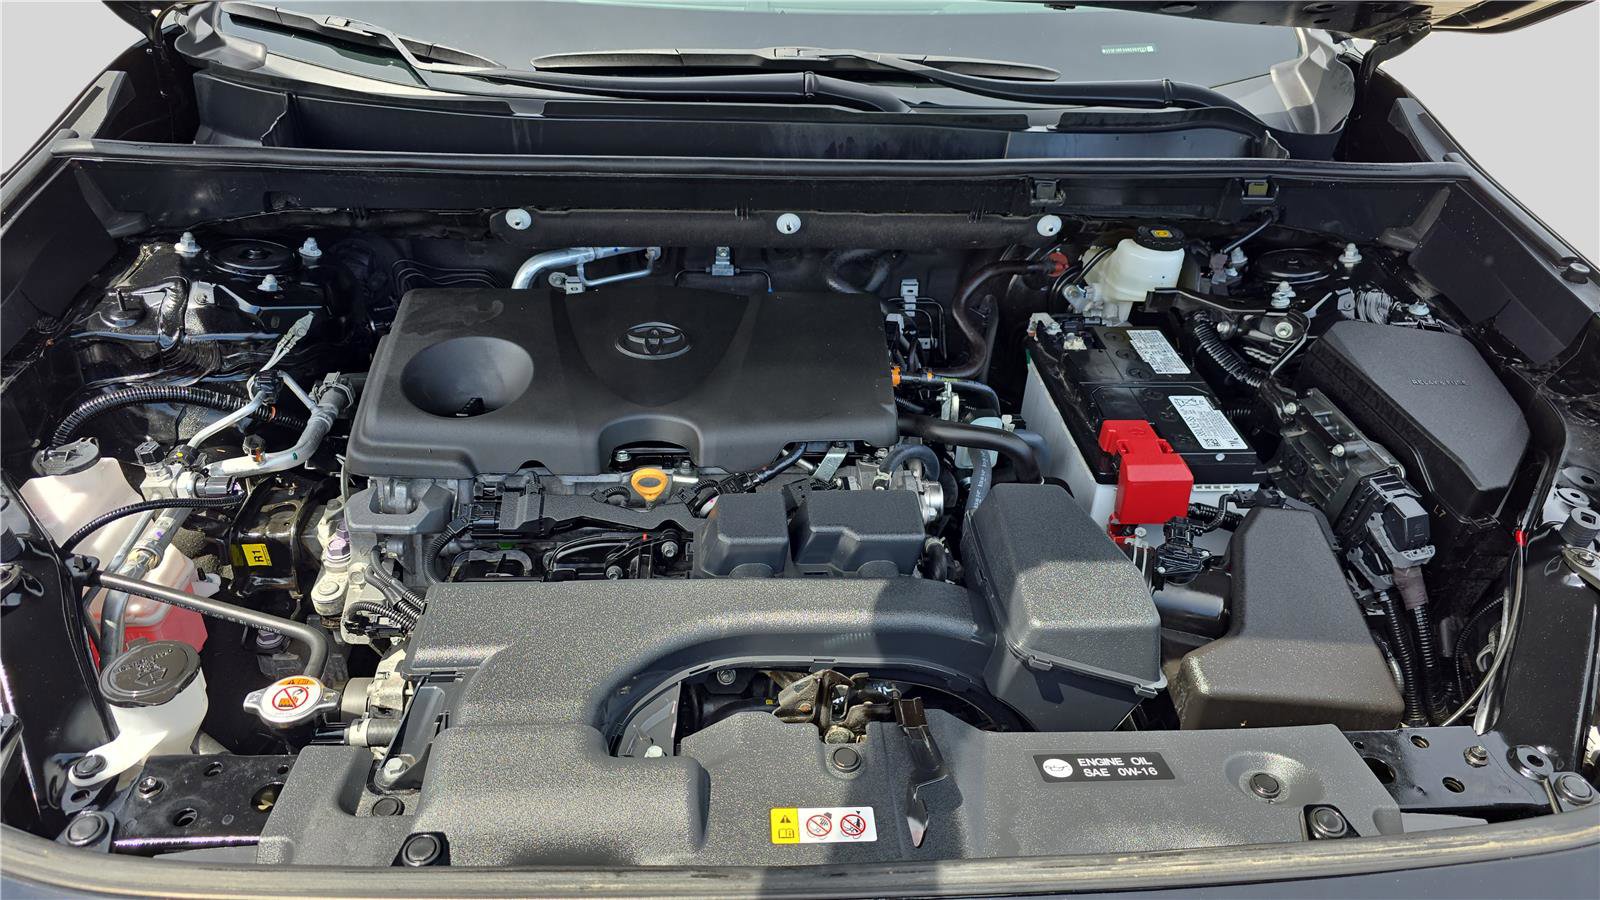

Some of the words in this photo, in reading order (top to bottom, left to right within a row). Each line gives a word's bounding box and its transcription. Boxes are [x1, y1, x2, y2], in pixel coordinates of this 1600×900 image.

[1077, 757, 1125, 766] ENGINE
[1130, 757, 1153, 765] OIL
[1083, 768, 1111, 777] SAE
[1117, 767, 1158, 776] 0W-16
